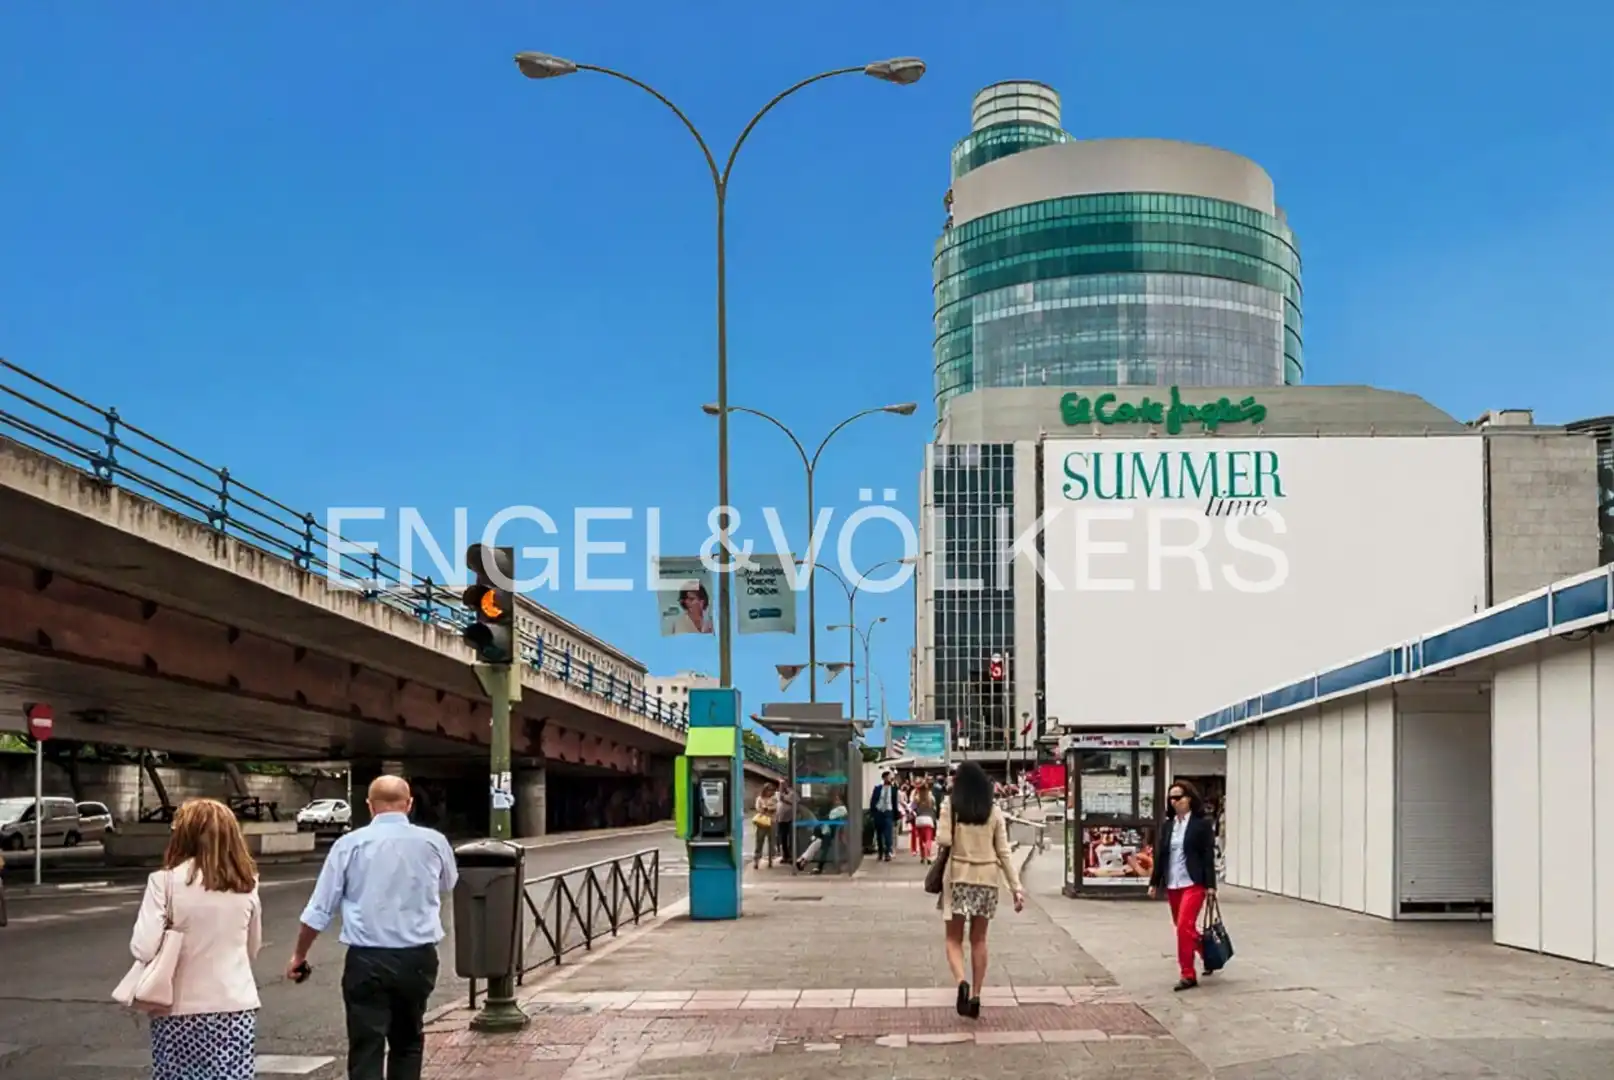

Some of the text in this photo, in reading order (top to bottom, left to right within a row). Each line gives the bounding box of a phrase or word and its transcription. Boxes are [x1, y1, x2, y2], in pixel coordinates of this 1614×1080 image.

[1060, 392, 1091, 426] El
[1094, 392, 1164, 425] Corte
[1062, 450, 1287, 500] SUMMER
[1204, 490, 1268, 517] time
